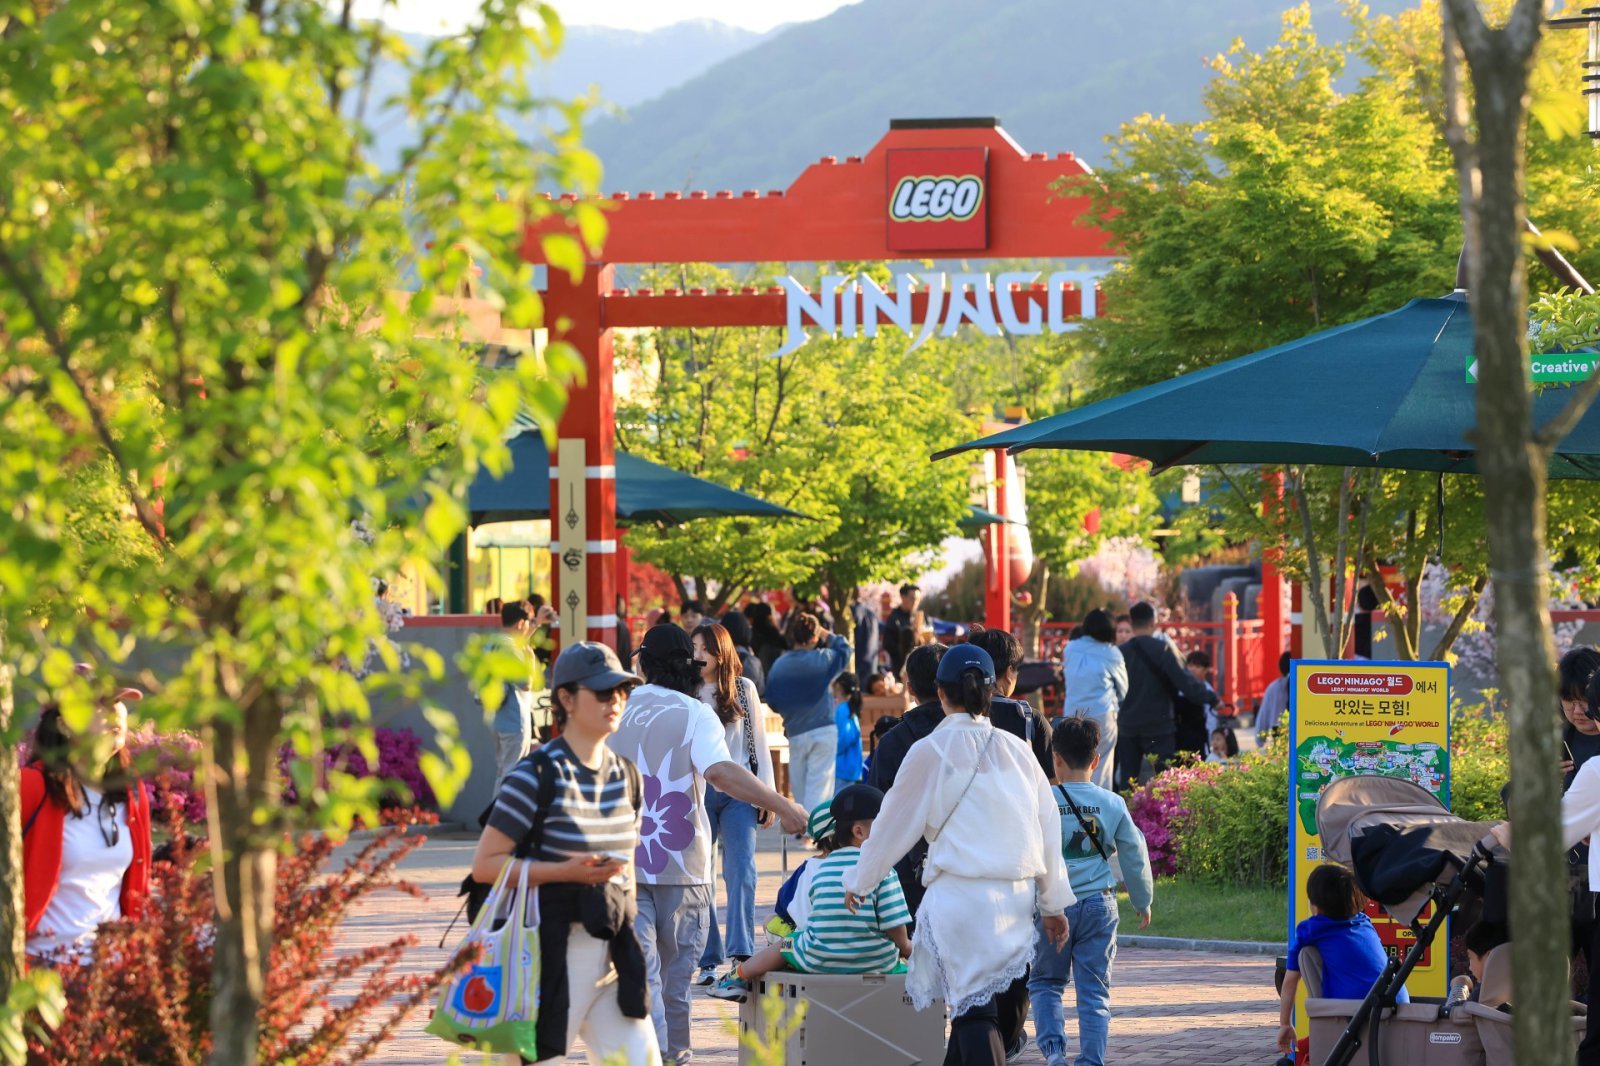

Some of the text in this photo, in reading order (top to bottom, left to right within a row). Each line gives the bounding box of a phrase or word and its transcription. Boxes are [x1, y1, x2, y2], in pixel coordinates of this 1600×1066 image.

[892, 178, 980, 219] LEGO
[766, 271, 1110, 358] NINJAGO
[1531, 360, 1588, 373] Creative
[1387, 676, 1404, 687] 월드
[1415, 680, 1437, 694] 에서
[1334, 699, 1410, 716] 맛있는 모험!
[1083, 805, 1101, 815] BEAR
